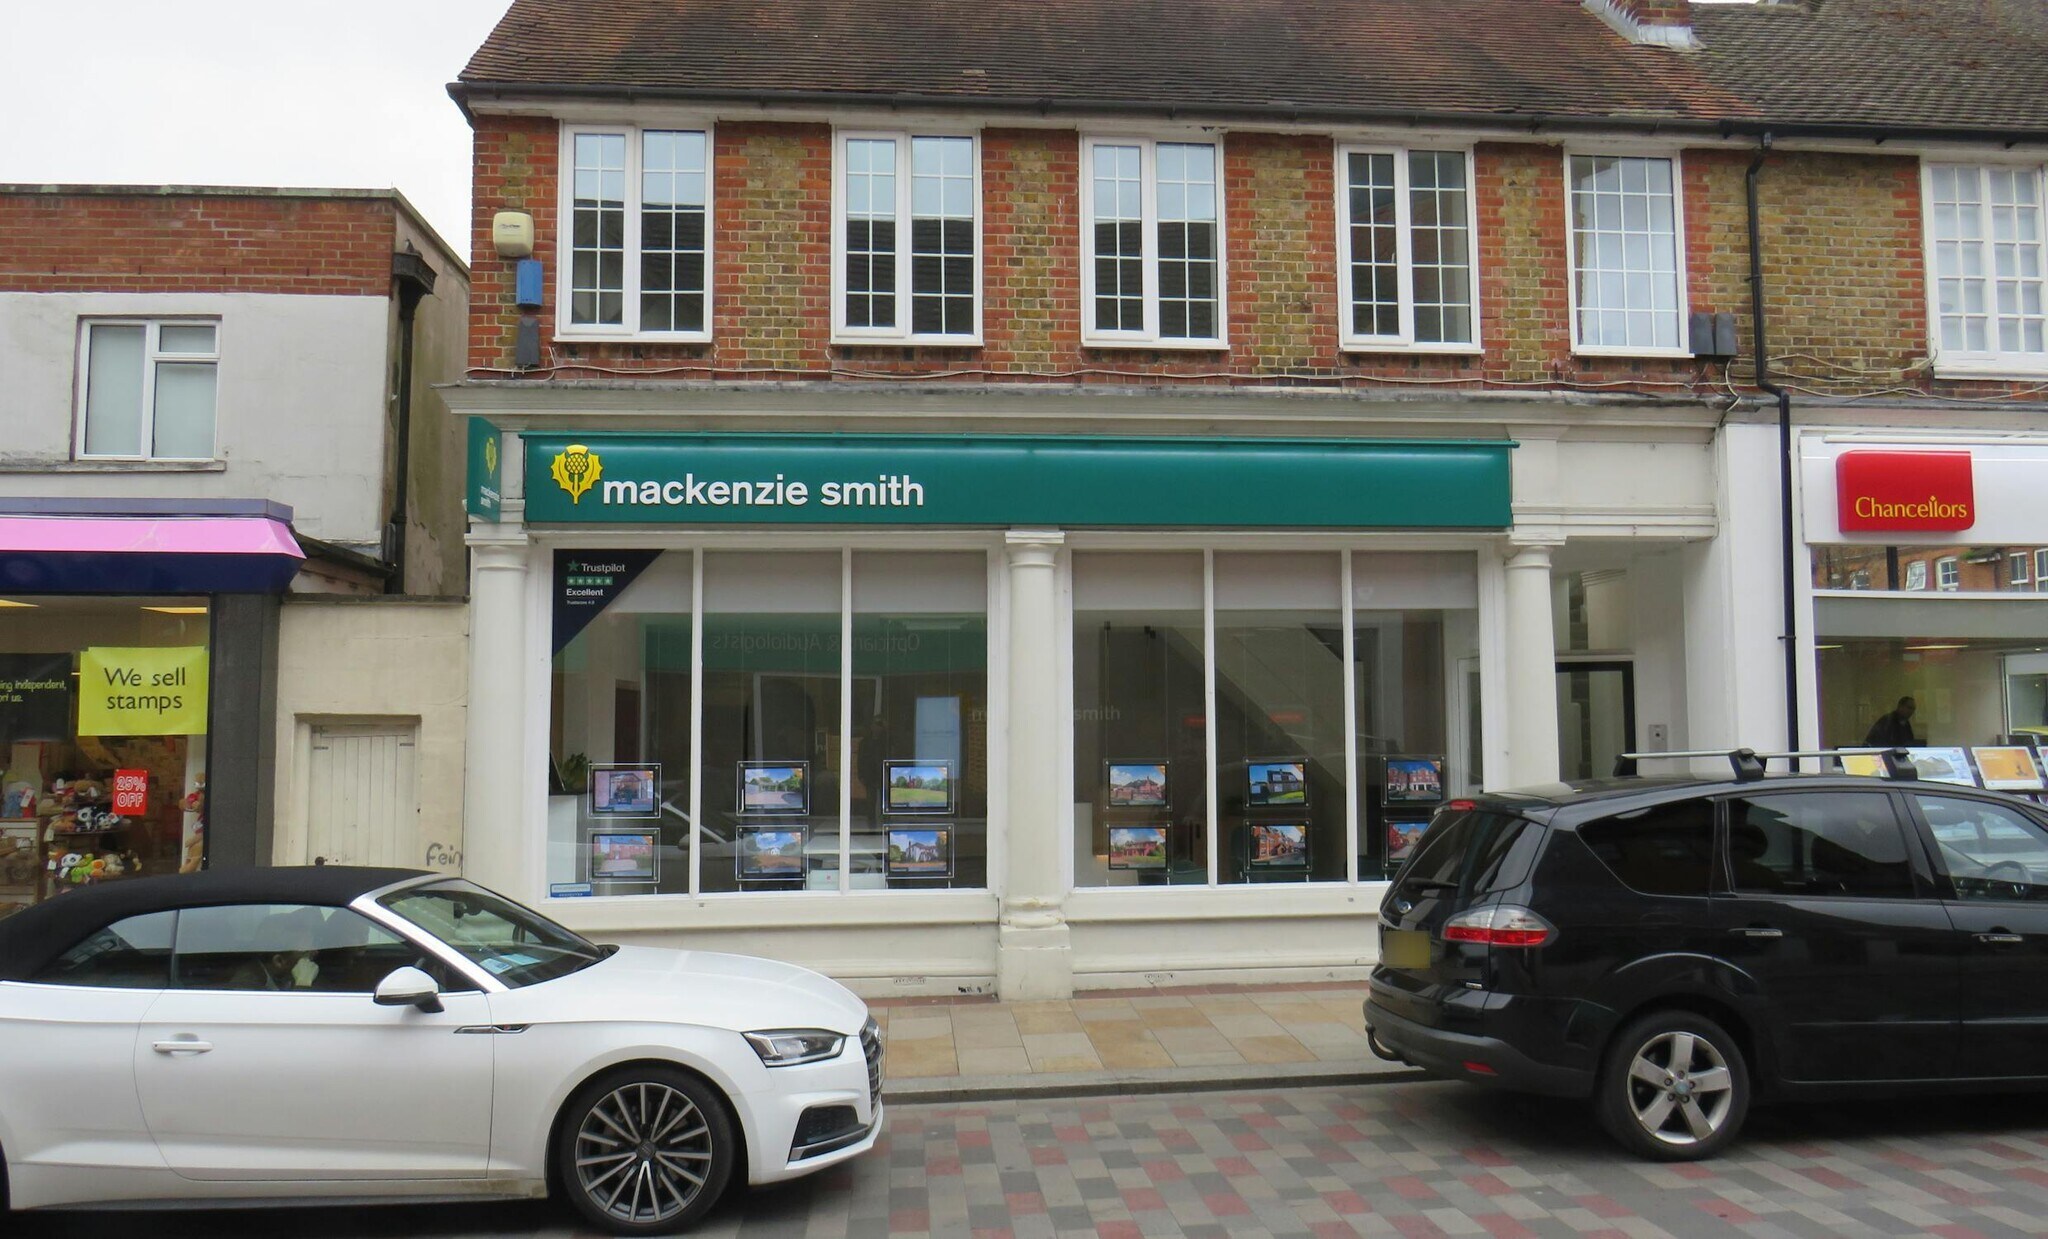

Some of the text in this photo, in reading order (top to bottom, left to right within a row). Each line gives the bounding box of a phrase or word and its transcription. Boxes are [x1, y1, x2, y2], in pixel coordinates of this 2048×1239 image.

[603, 473, 924, 506] mackenzie smith
[1855, 495, 1967, 518] Chancellors
[581, 563, 626, 574] Trustpilot
[566, 588, 604, 596] Excellent
[104, 667, 185, 686] We sell
[107, 694, 183, 715] stamps
[116, 776, 147, 792] 25%
[117, 792, 144, 808] OFF
